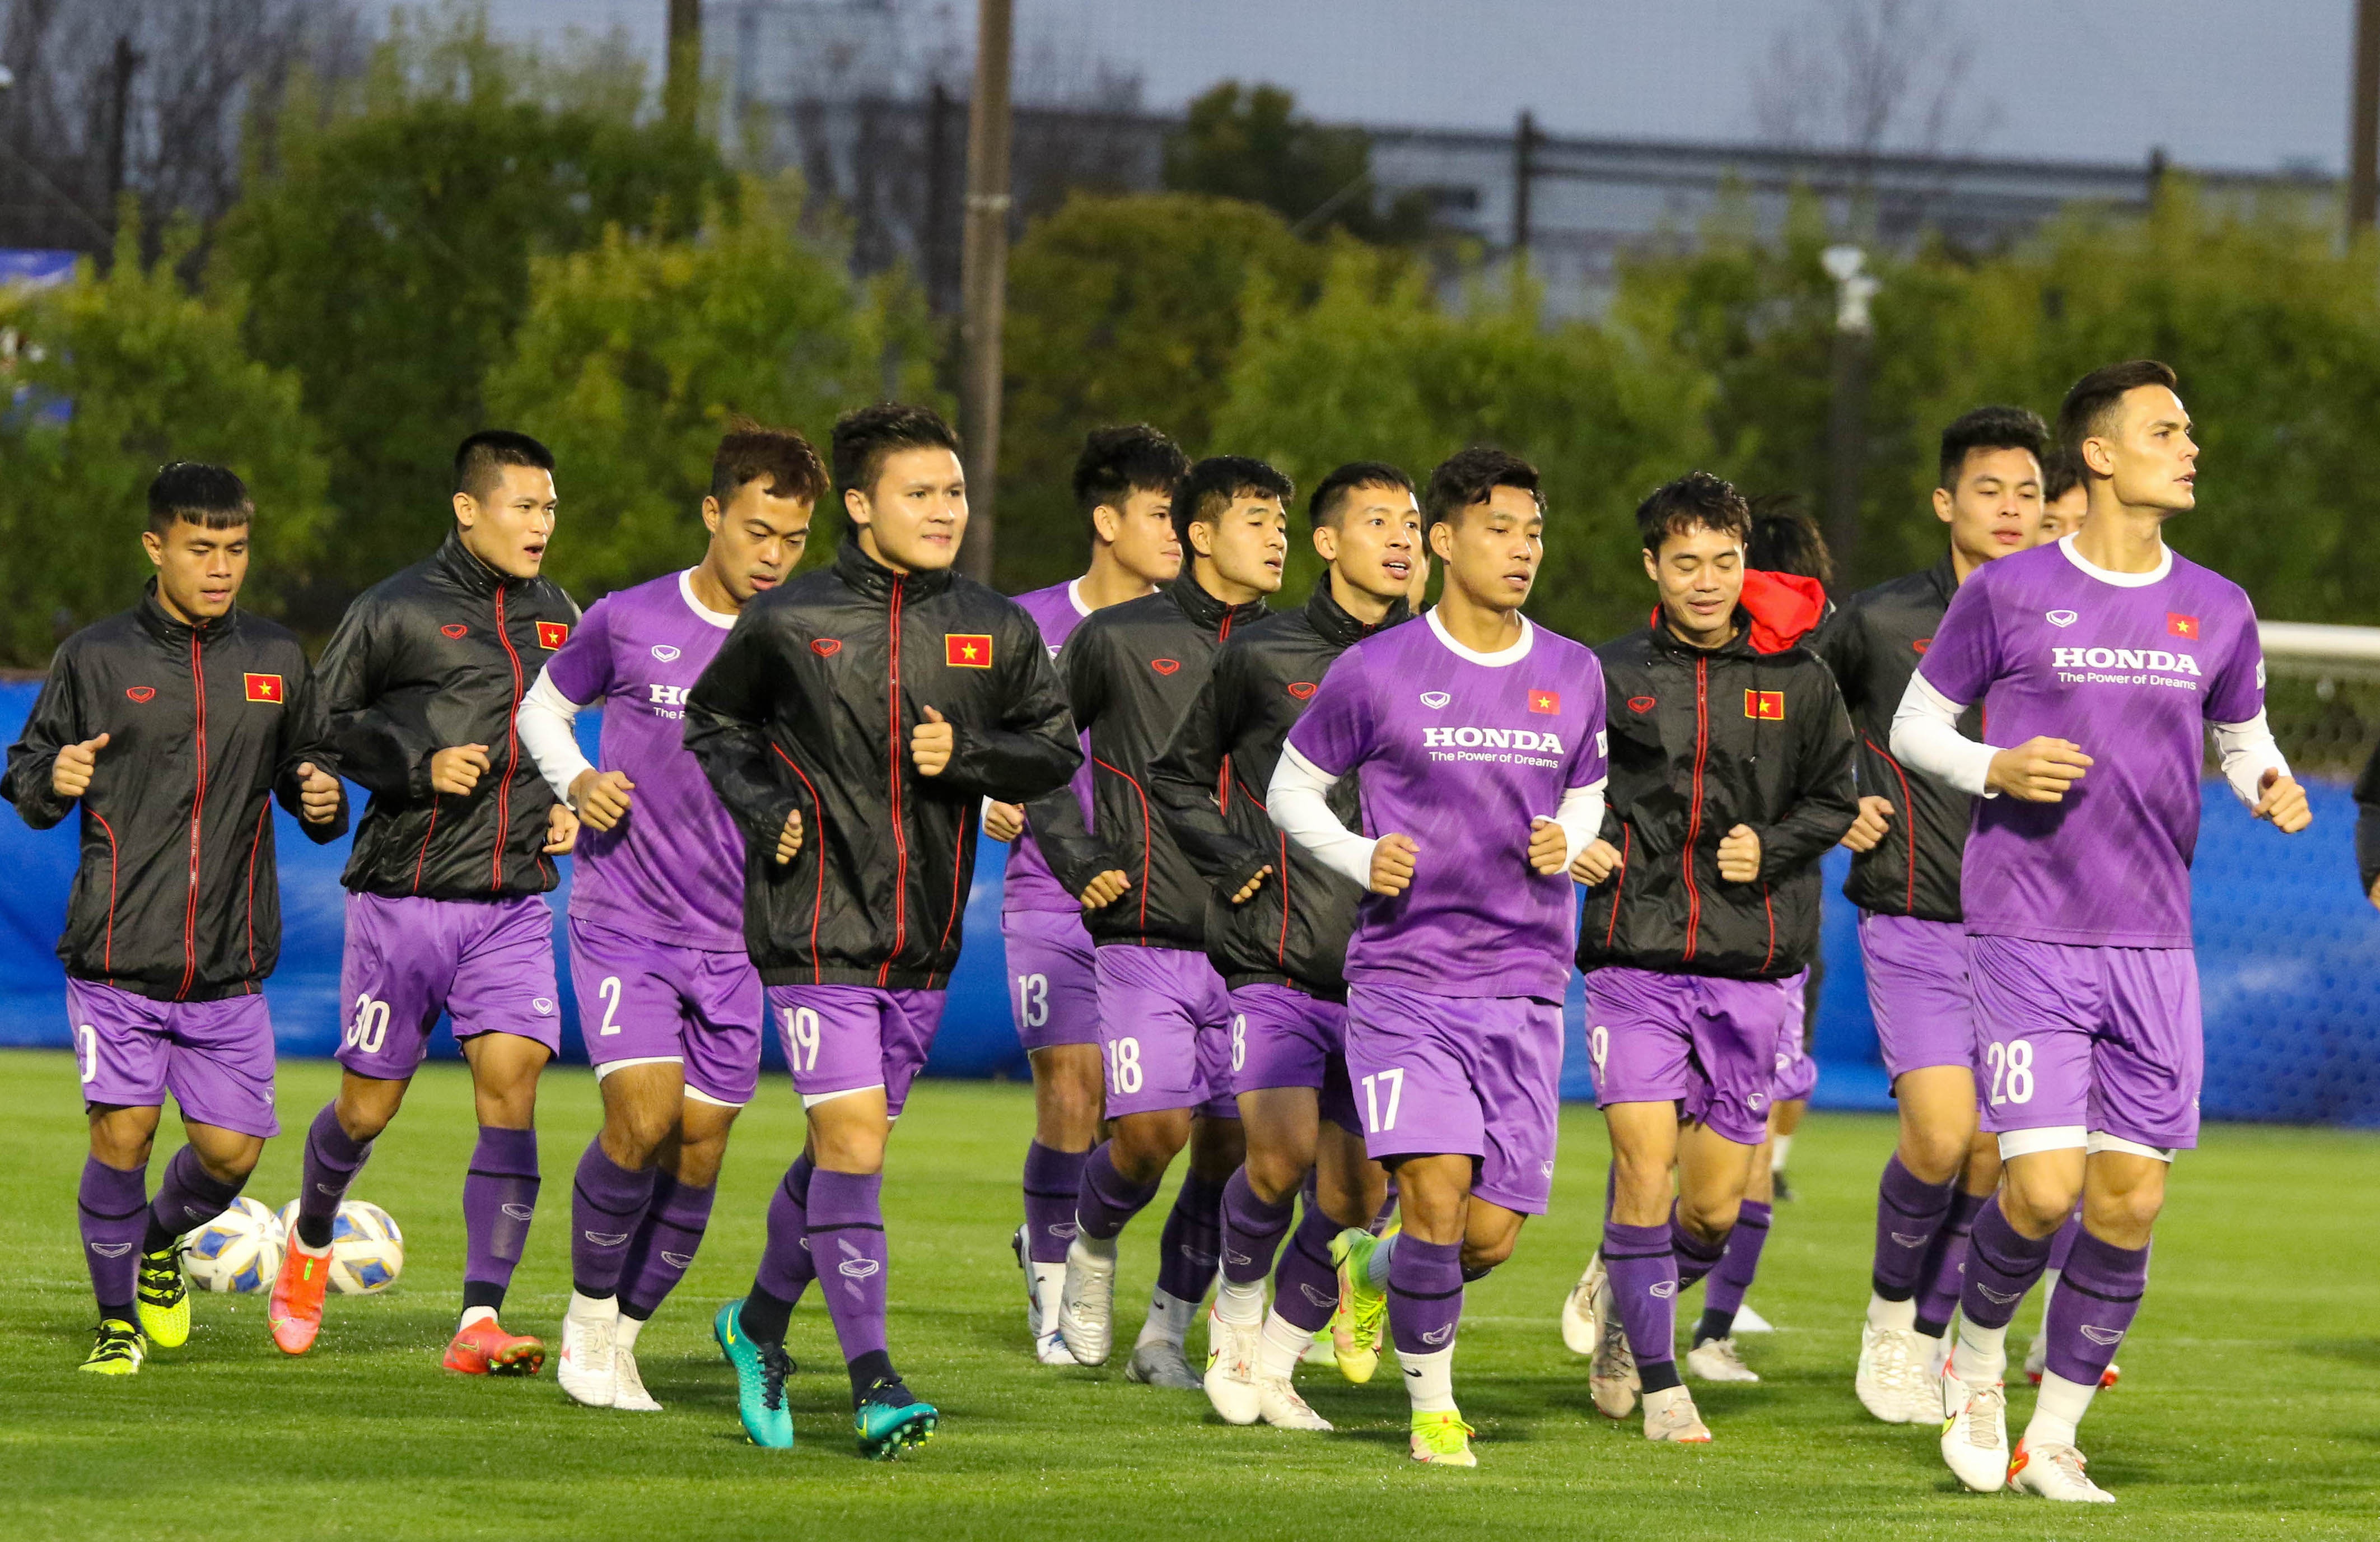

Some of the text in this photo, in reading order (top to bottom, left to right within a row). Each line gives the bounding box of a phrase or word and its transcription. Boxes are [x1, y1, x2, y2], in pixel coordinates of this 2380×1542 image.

[2051, 647, 2201, 676] HONDA
[2058, 672, 2197, 691] The Power of Dreams
[653, 707, 676, 719] The
[1422, 727, 1564, 754] HONDA
[1429, 751, 1558, 768] The Power of Dreams
[347, 993, 390, 1054] 30
[599, 976, 622, 1036] 2
[1018, 973, 1049, 1028] 13
[783, 1007, 820, 1071] 19
[1108, 1036, 1143, 1094] 18
[1232, 1013, 1247, 1072] 8
[1592, 1025, 1609, 1084] 9
[1361, 1067, 1404, 1134] 17
[1987, 1039, 2034, 1106] 28
